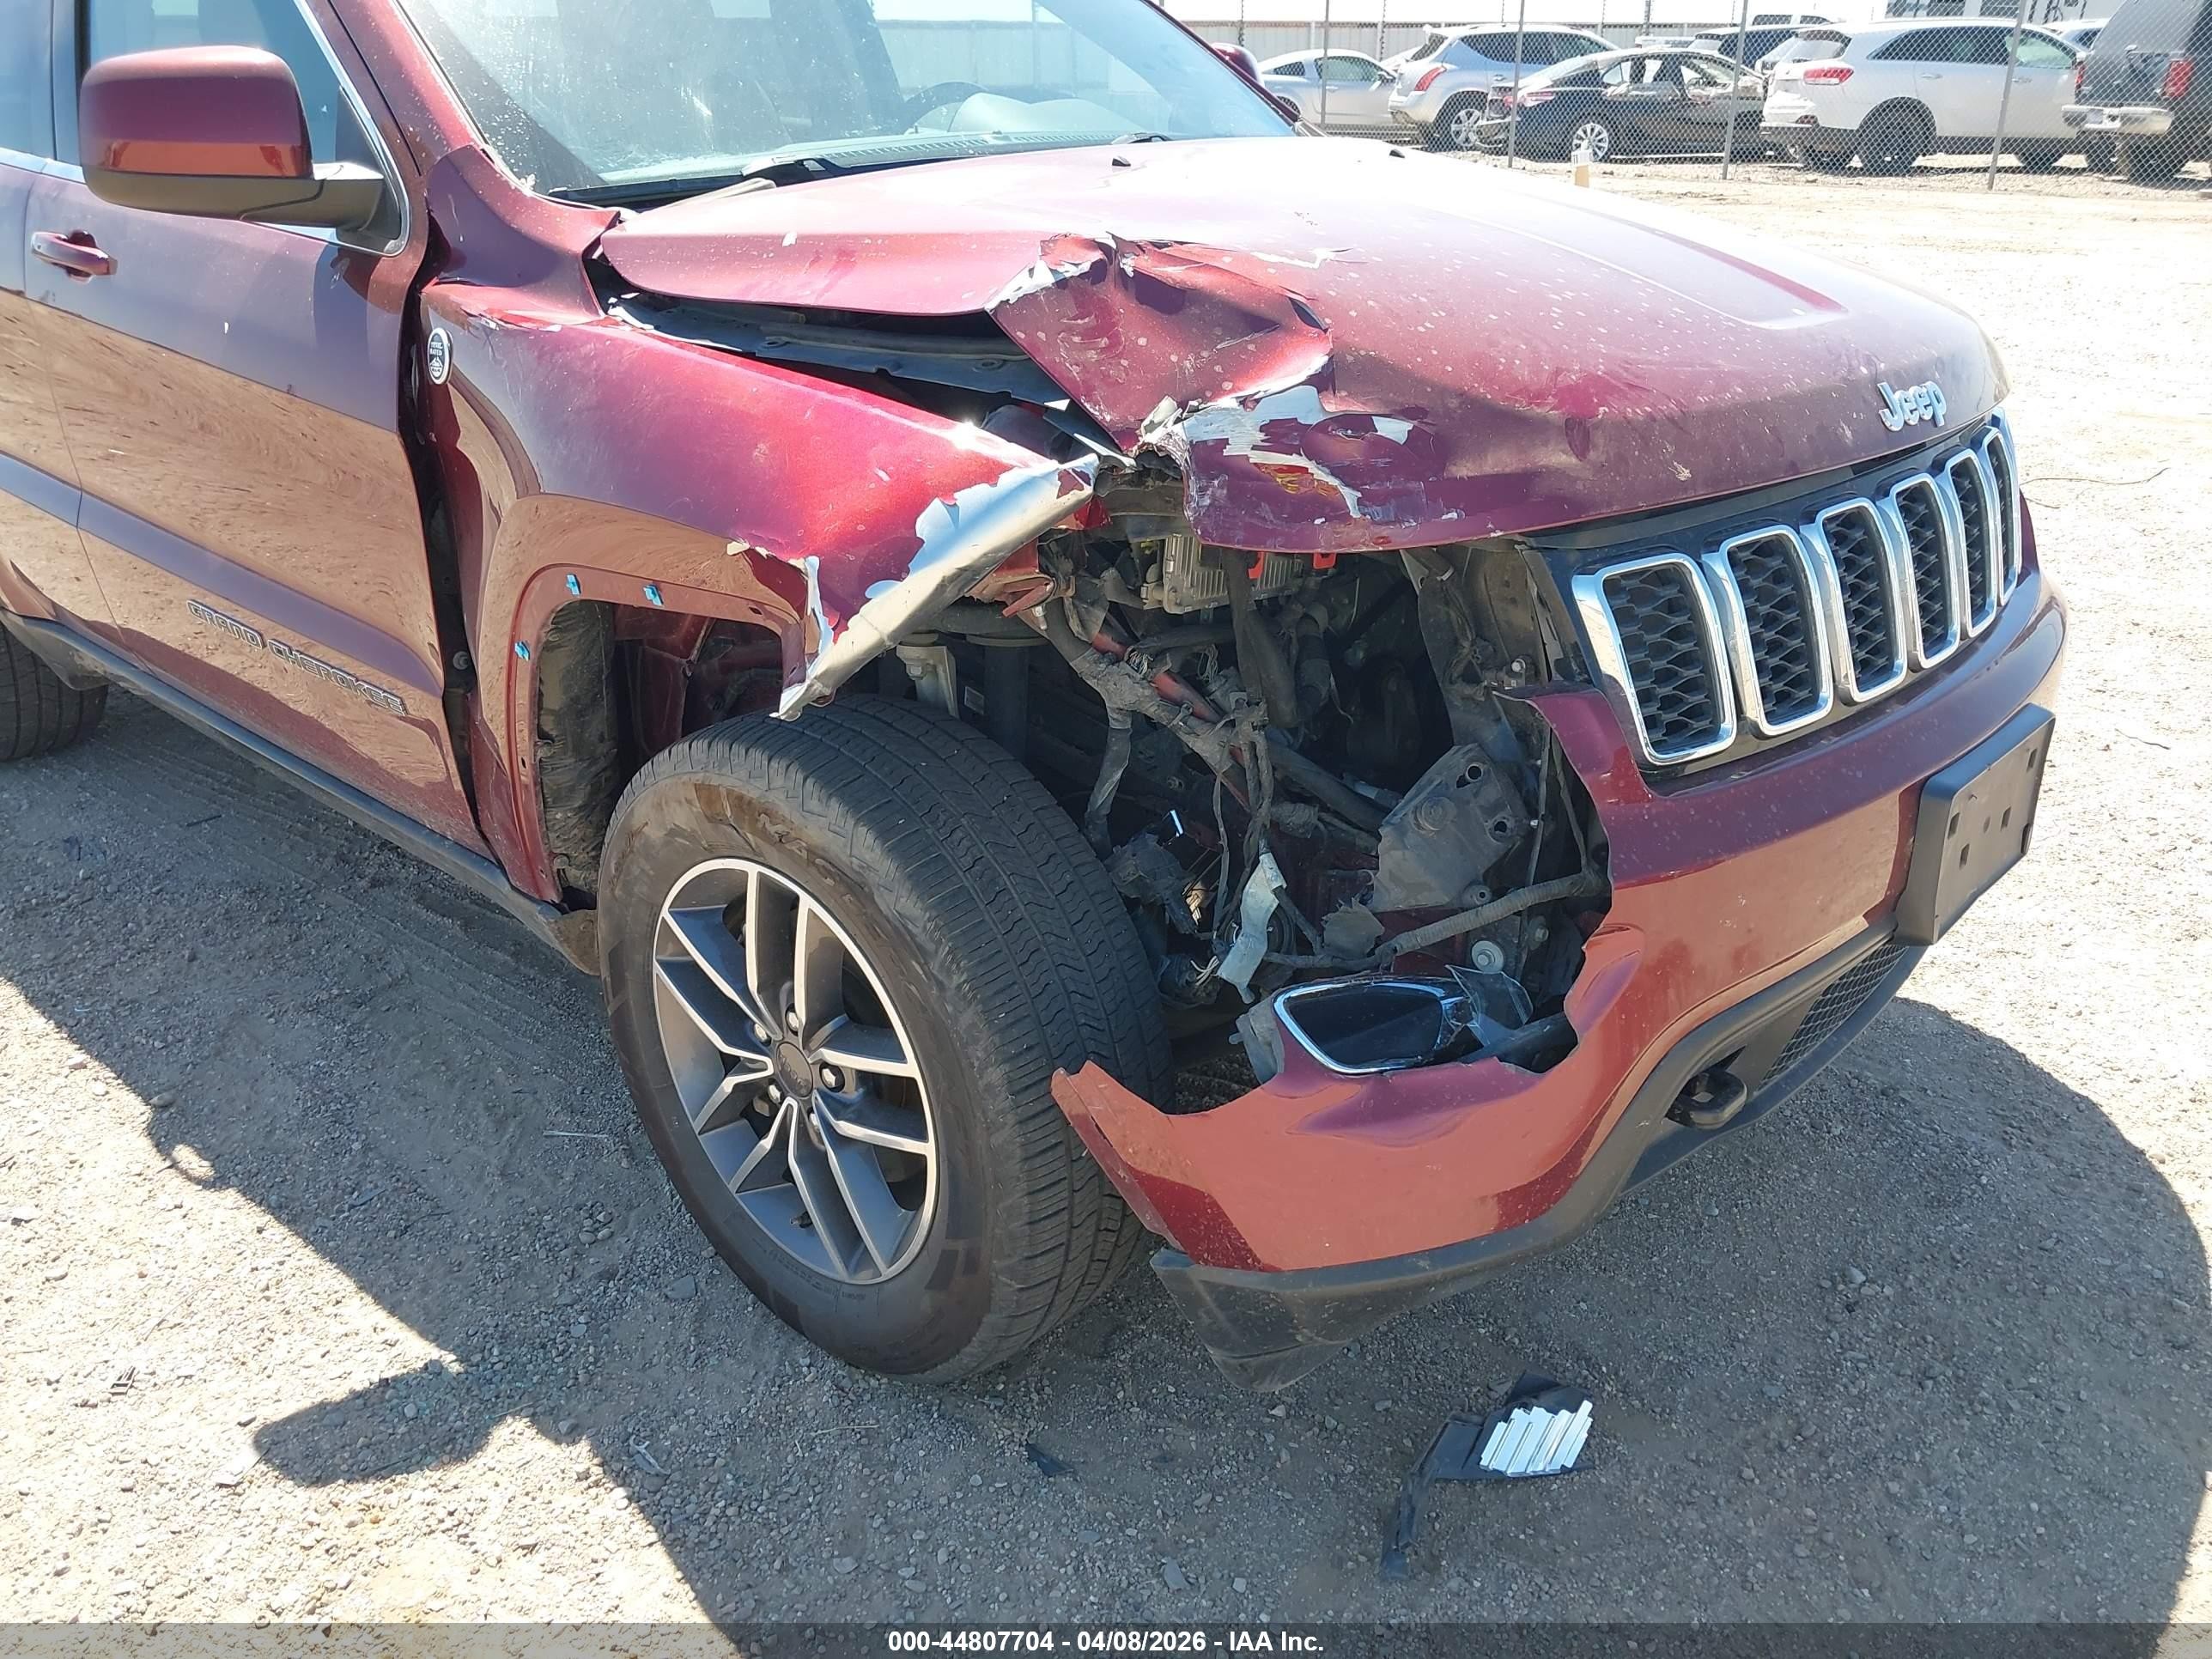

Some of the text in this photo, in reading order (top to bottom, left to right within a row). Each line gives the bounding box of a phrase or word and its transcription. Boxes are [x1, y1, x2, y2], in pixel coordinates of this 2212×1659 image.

[1877, 380, 1947, 432] Jeep
[186, 599, 409, 716] GRAND CHEROKEE
